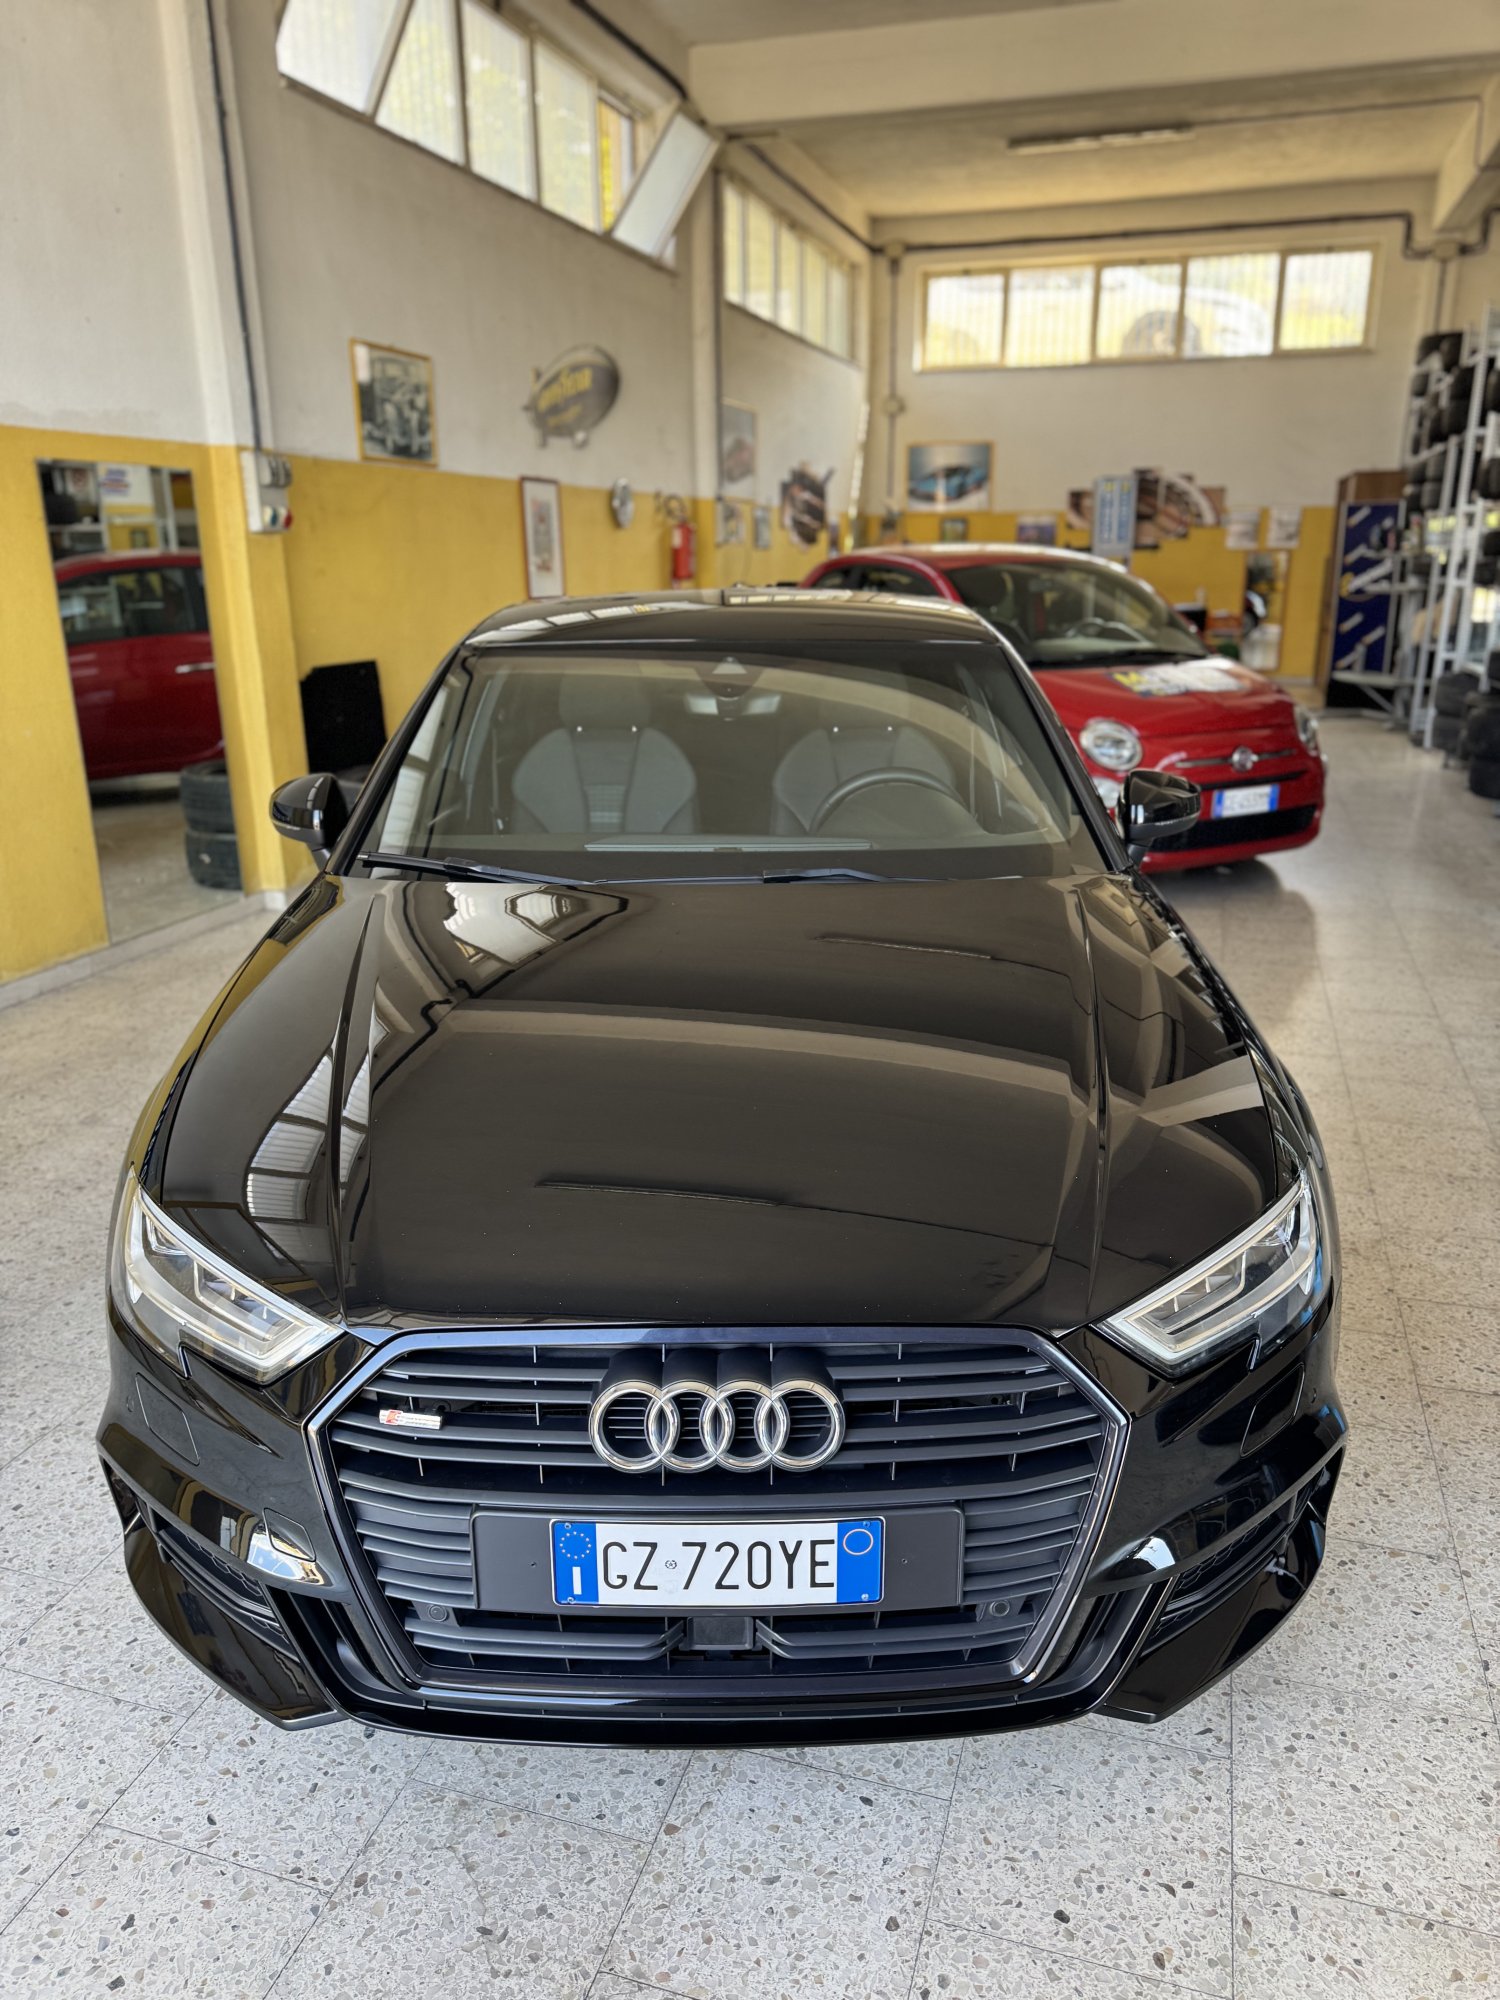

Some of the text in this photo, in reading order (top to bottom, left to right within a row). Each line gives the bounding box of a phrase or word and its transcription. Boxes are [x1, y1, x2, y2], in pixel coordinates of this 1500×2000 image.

[572, 1566, 583, 1595] I
[602, 1538, 836, 1591] GZ 720YE
